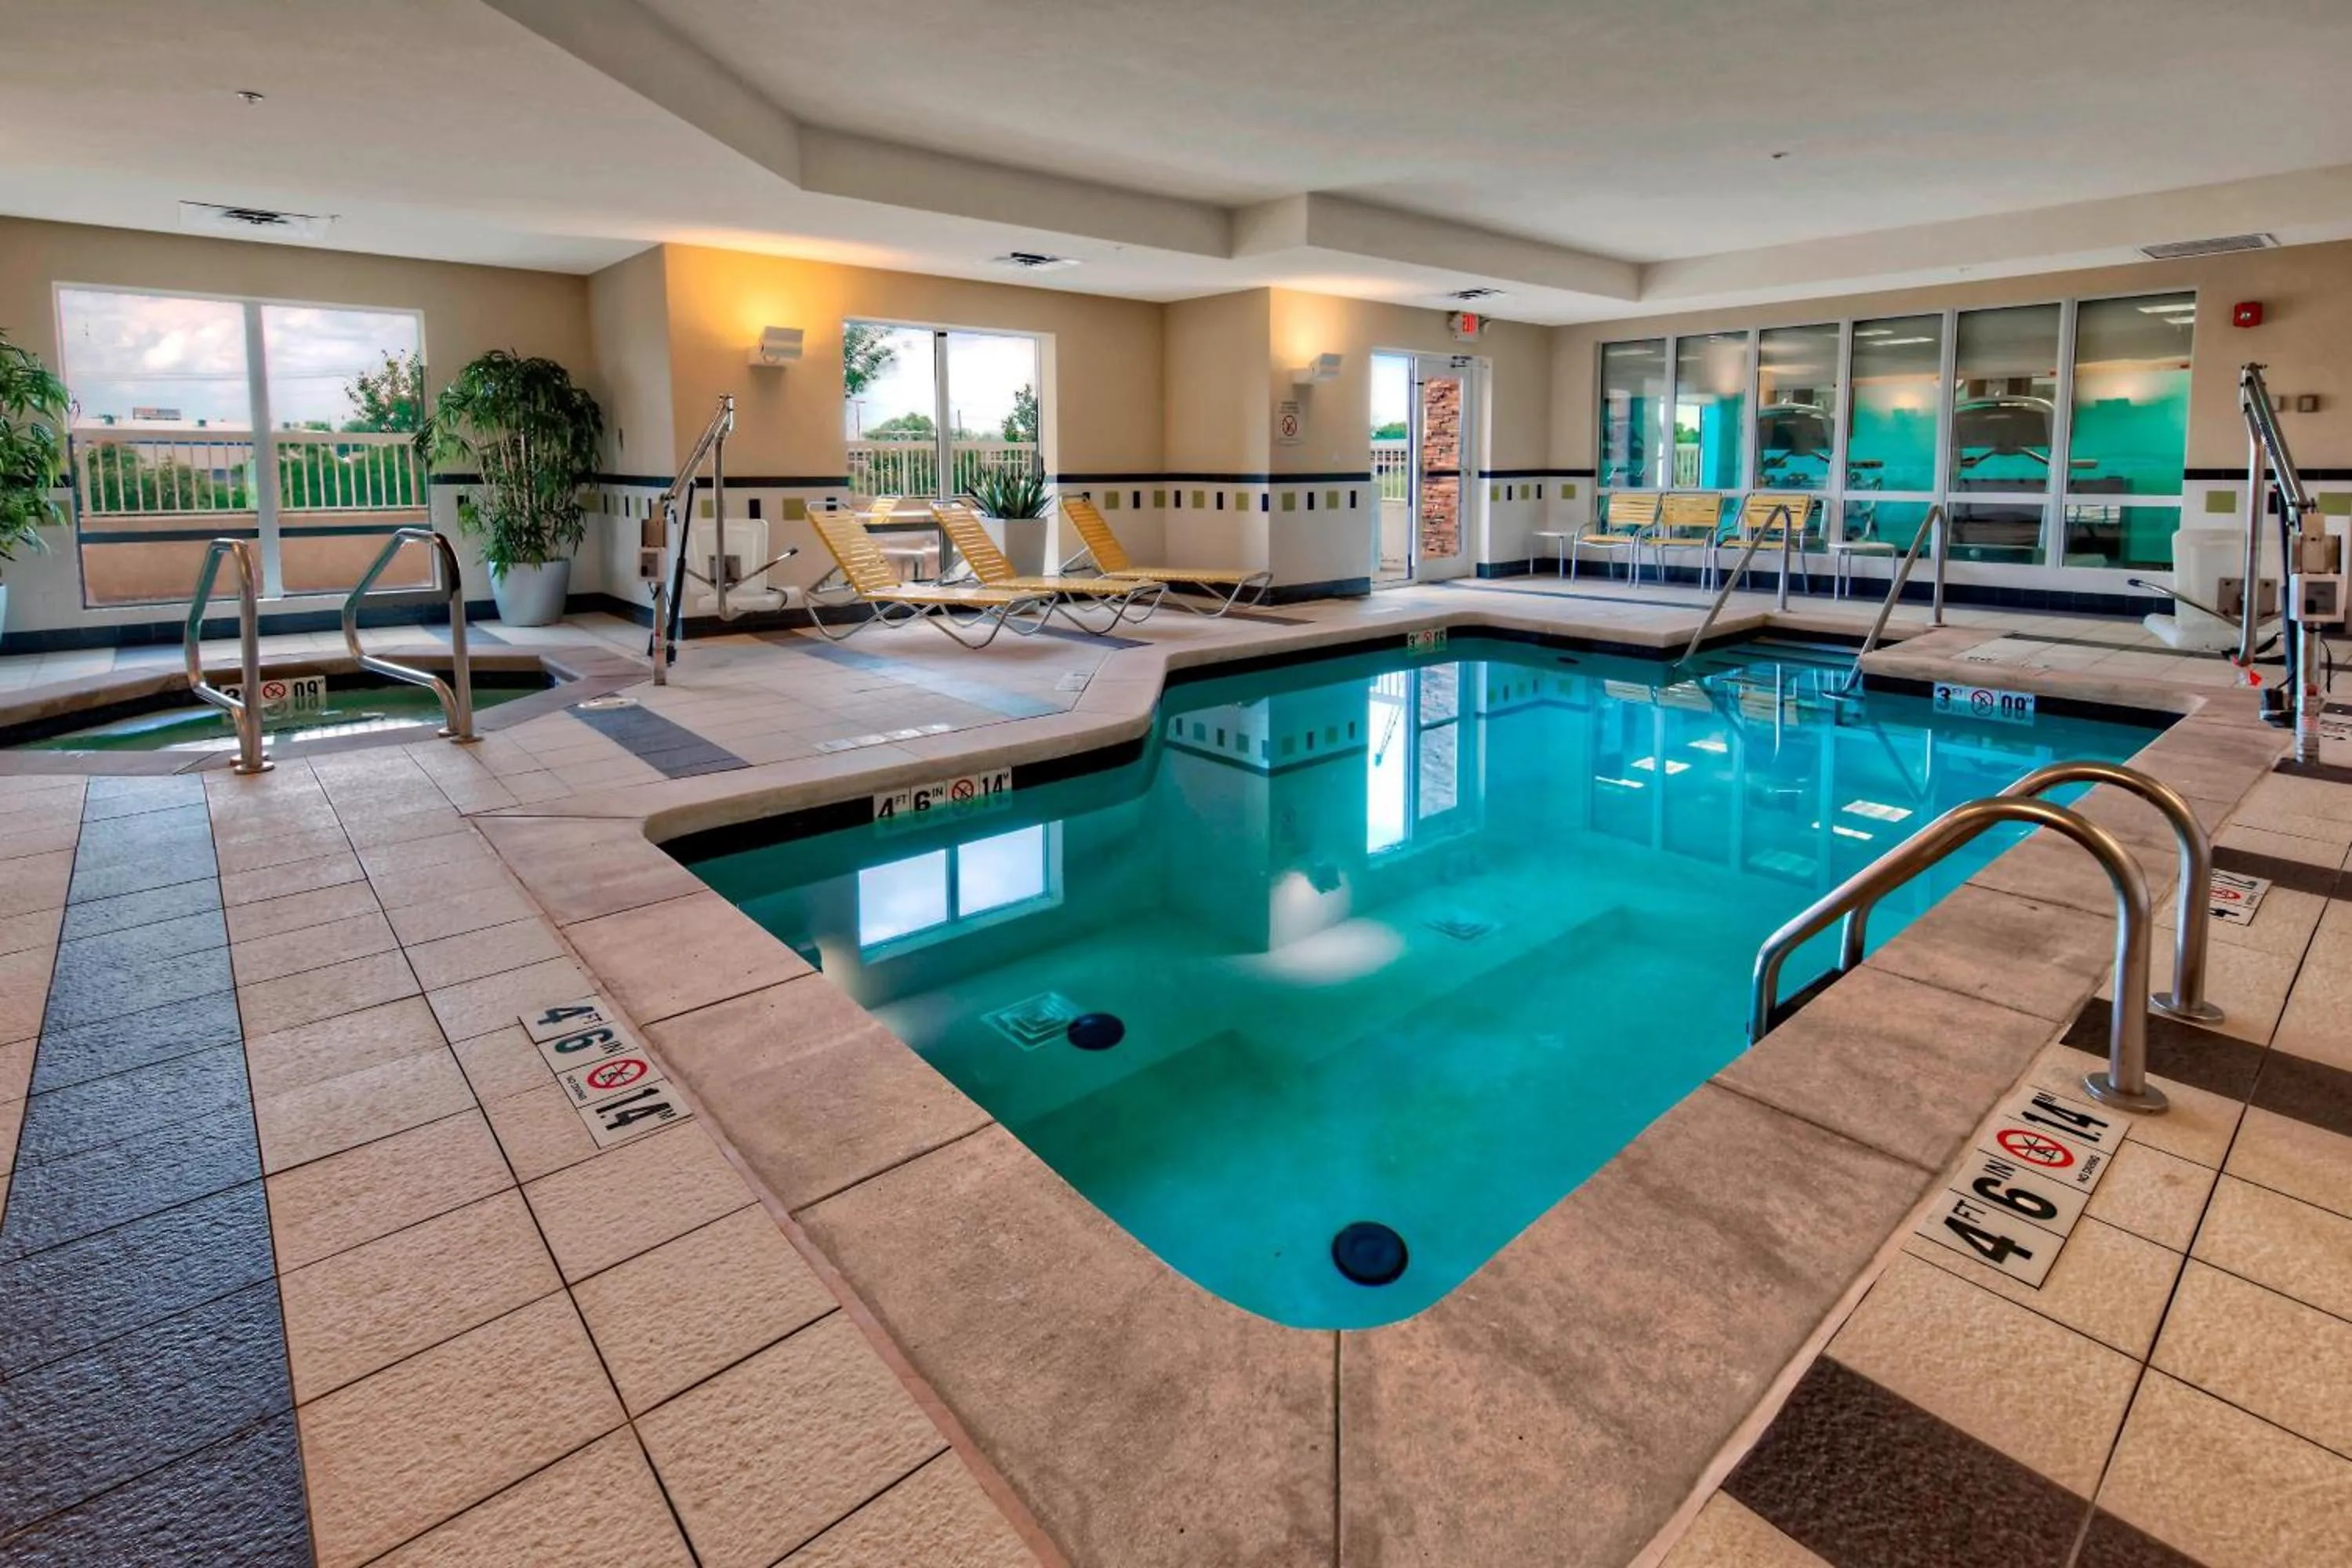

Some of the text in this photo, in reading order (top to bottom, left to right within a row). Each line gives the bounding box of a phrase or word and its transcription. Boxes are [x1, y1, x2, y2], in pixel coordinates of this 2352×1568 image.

[877, 797, 895, 818] 4
[895, 794, 907, 805] FT
[914, 790, 931, 811] 6
[932, 786, 943, 798] IN
[537, 1005, 594, 1025] 4
[582, 1012, 603, 1025] FT
[554, 1028, 614, 1054] 6
[600, 1041, 625, 1054] IN
[1982, 1160, 2016, 1179] IN
[1972, 1176, 2058, 1219] 6
[1952, 1200, 1986, 1224] FT
[1944, 1216, 2033, 1265] 4
